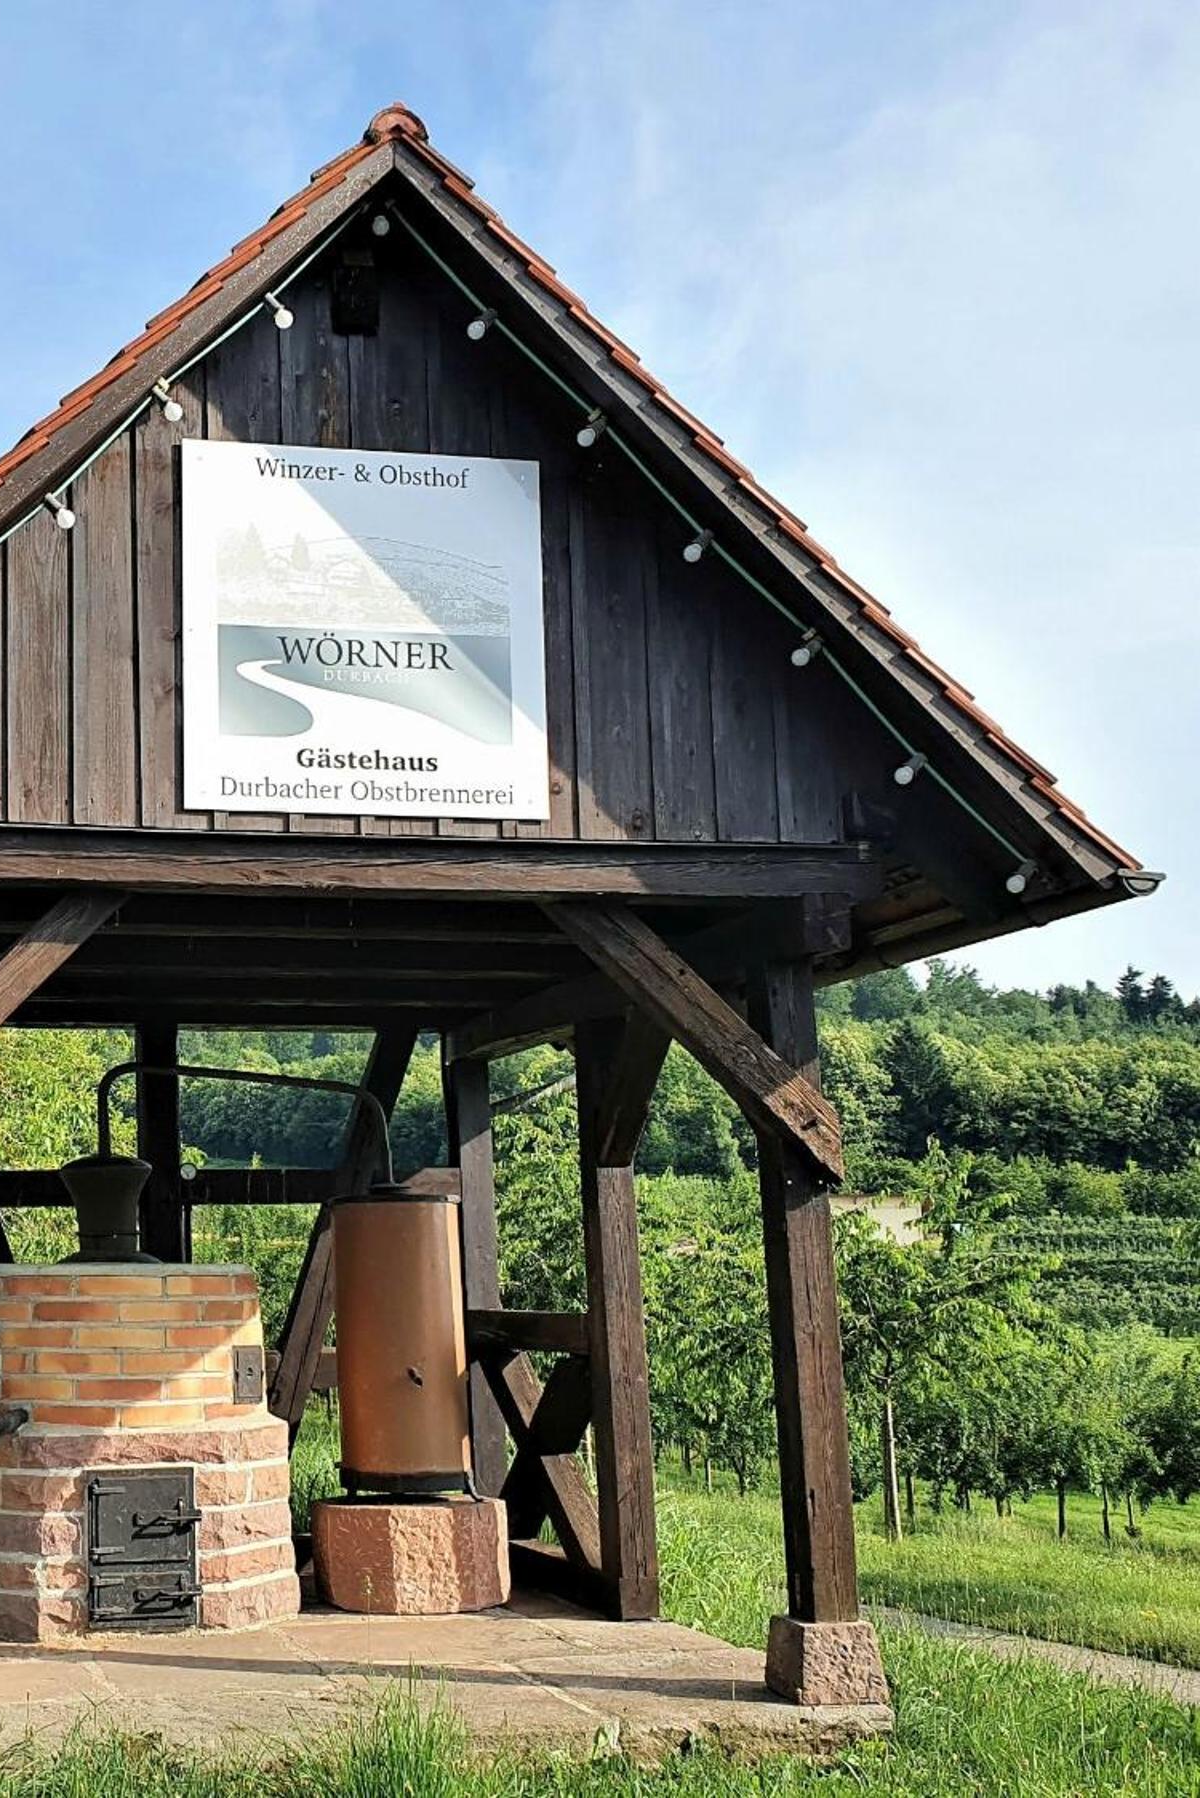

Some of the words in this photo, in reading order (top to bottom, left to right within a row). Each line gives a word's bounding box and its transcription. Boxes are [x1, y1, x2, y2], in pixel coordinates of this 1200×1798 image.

[256, 457, 346, 482] Winzer-
[354, 463, 372, 484] &
[379, 464, 469, 489] Obsthof
[276, 633, 455, 671] WÖRNER
[296, 748, 439, 772] Gästehaus
[220, 777, 344, 801] Durbacher
[350, 779, 515, 805] Obstbrennerei
